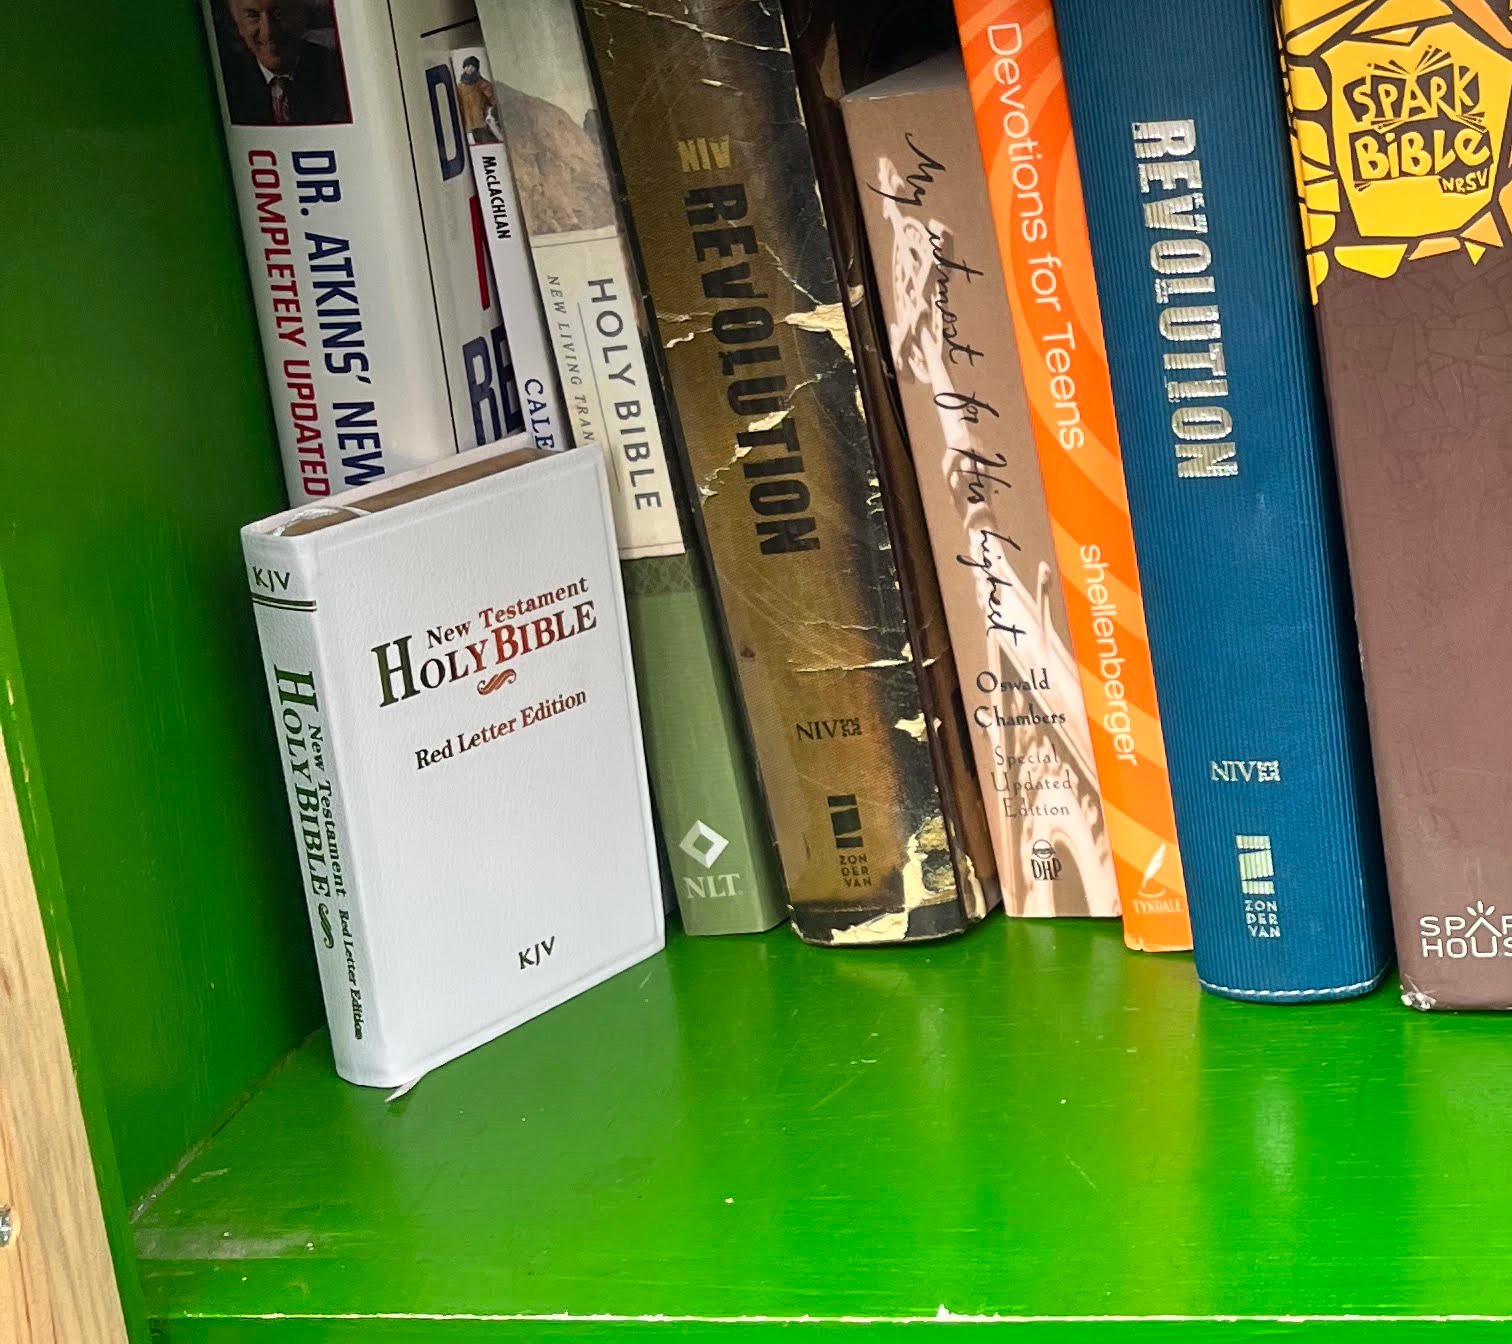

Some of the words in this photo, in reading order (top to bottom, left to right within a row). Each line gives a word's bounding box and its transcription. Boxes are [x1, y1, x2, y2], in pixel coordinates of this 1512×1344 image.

[1352, 64, 1476, 123] SPARK
[677, 135, 730, 173] NIV
[987, 23, 1047, 243] Devotions
[866, 133, 946, 206] My
[1441, 172, 1489, 193] NRSV
[1029, 253, 1063, 313] for
[1132, 119, 1239, 478] REVOLUTION
[247, 150, 307, 347] COMPLETELY
[281, 359, 331, 496] UPDATED
[291, 150, 341, 217] DR.
[332, 402, 386, 486] NEW
[547, 275, 566, 314] NEW
[558, 322, 583, 386] LIVING
[682, 182, 821, 555] REVOLUTION
[1042, 322, 1085, 450] Teens
[587, 277, 636, 387] HOLY
[614, 400, 662, 511] BIBLE
[252, 565, 291, 593] KJV
[426, 618, 472, 649] New
[479, 576, 590, 631] Testament
[371, 634, 488, 708] HOLY
[493, 600, 597, 666] BIBLE
[1079, 543, 1137, 766] shellenberger
[976, 669, 1050, 694] Oswald
[273, 663, 317, 778] HOLY
[415, 740, 455, 770] Red
[458, 717, 517, 754] Letter
[521, 687, 588, 729] Edition
[796, 718, 840, 743] NIV
[974, 704, 1066, 729] Chambers
[309, 724, 325, 770] New
[995, 746, 1059, 767] Special
[991, 768, 1072, 794] Updated
[1210, 761, 1257, 782] NIV
[1003, 798, 1070, 819] Edition
[294, 781, 333, 898] BIBLE
[318, 778, 347, 897] Testament
[839, 854, 868, 866] ZON
[680, 872, 739, 900] NLT
[841, 866, 869, 877] DER
[843, 877, 872, 888] VAN
[338, 909, 352, 939] Red
[1132, 898, 1183, 914] TYNDALE
[1245, 900, 1278, 912] ZON
[1246, 913, 1280, 926] DER
[518, 935, 556, 970] KJV
[1248, 926, 1281, 939] VAN
[341, 939, 358, 989] Letter
[349, 987, 364, 1040] Edition
